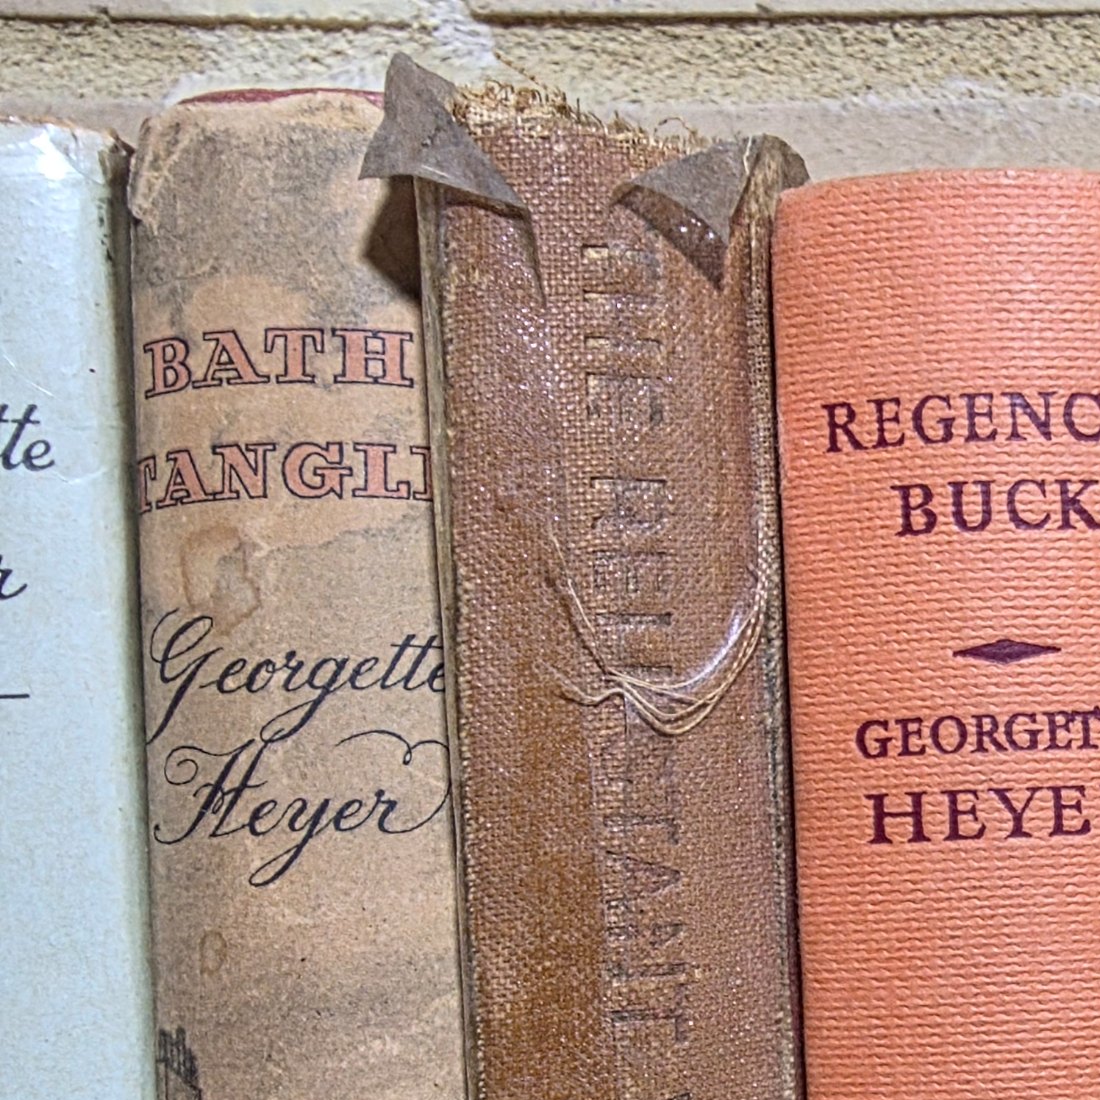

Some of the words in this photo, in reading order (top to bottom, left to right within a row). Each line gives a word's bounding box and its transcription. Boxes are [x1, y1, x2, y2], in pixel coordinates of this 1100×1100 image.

[143, 327, 414, 399] BATH
[146, 608, 445, 746] Georgette
[154, 729, 452, 887] Heyer
